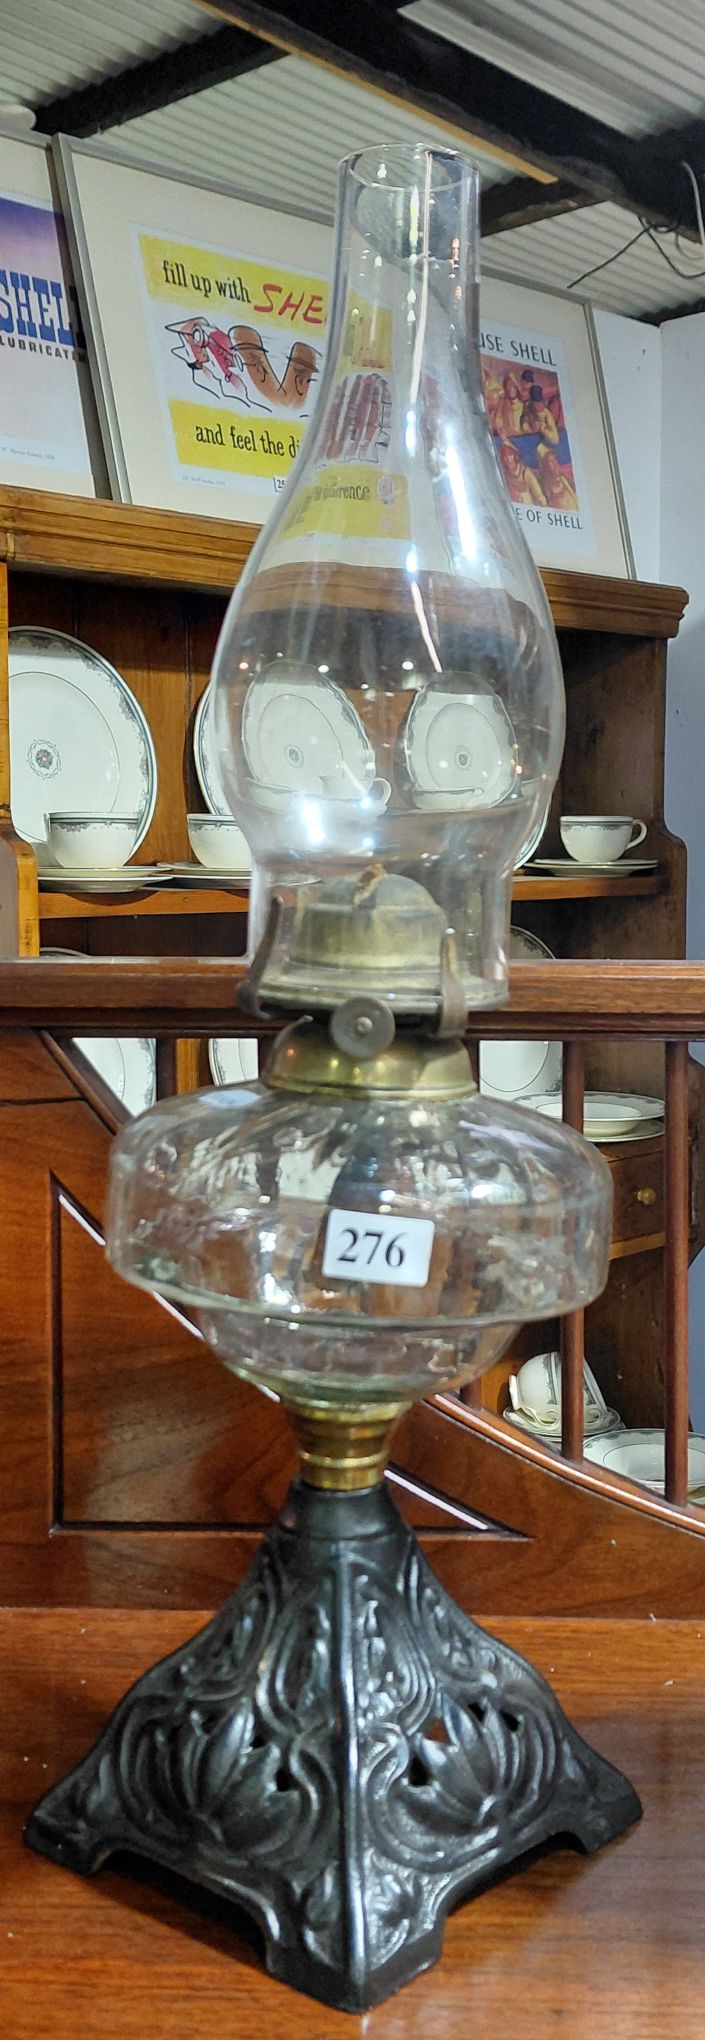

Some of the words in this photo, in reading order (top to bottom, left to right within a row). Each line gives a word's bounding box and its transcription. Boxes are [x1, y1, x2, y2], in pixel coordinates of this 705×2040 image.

[162, 260, 187, 288] fill
[190, 273, 212, 298] up
[215, 277, 251, 304] with
[253, 283, 328, 324] SHE
[510, 339, 557, 366] SHELL
[195, 423, 226, 447] and
[230, 425, 257, 452] feel
[259, 430, 285, 457] the
[526, 509, 542, 524] OF
[547, 512, 584, 530] SHELL
[337, 1226, 408, 1268] 276
